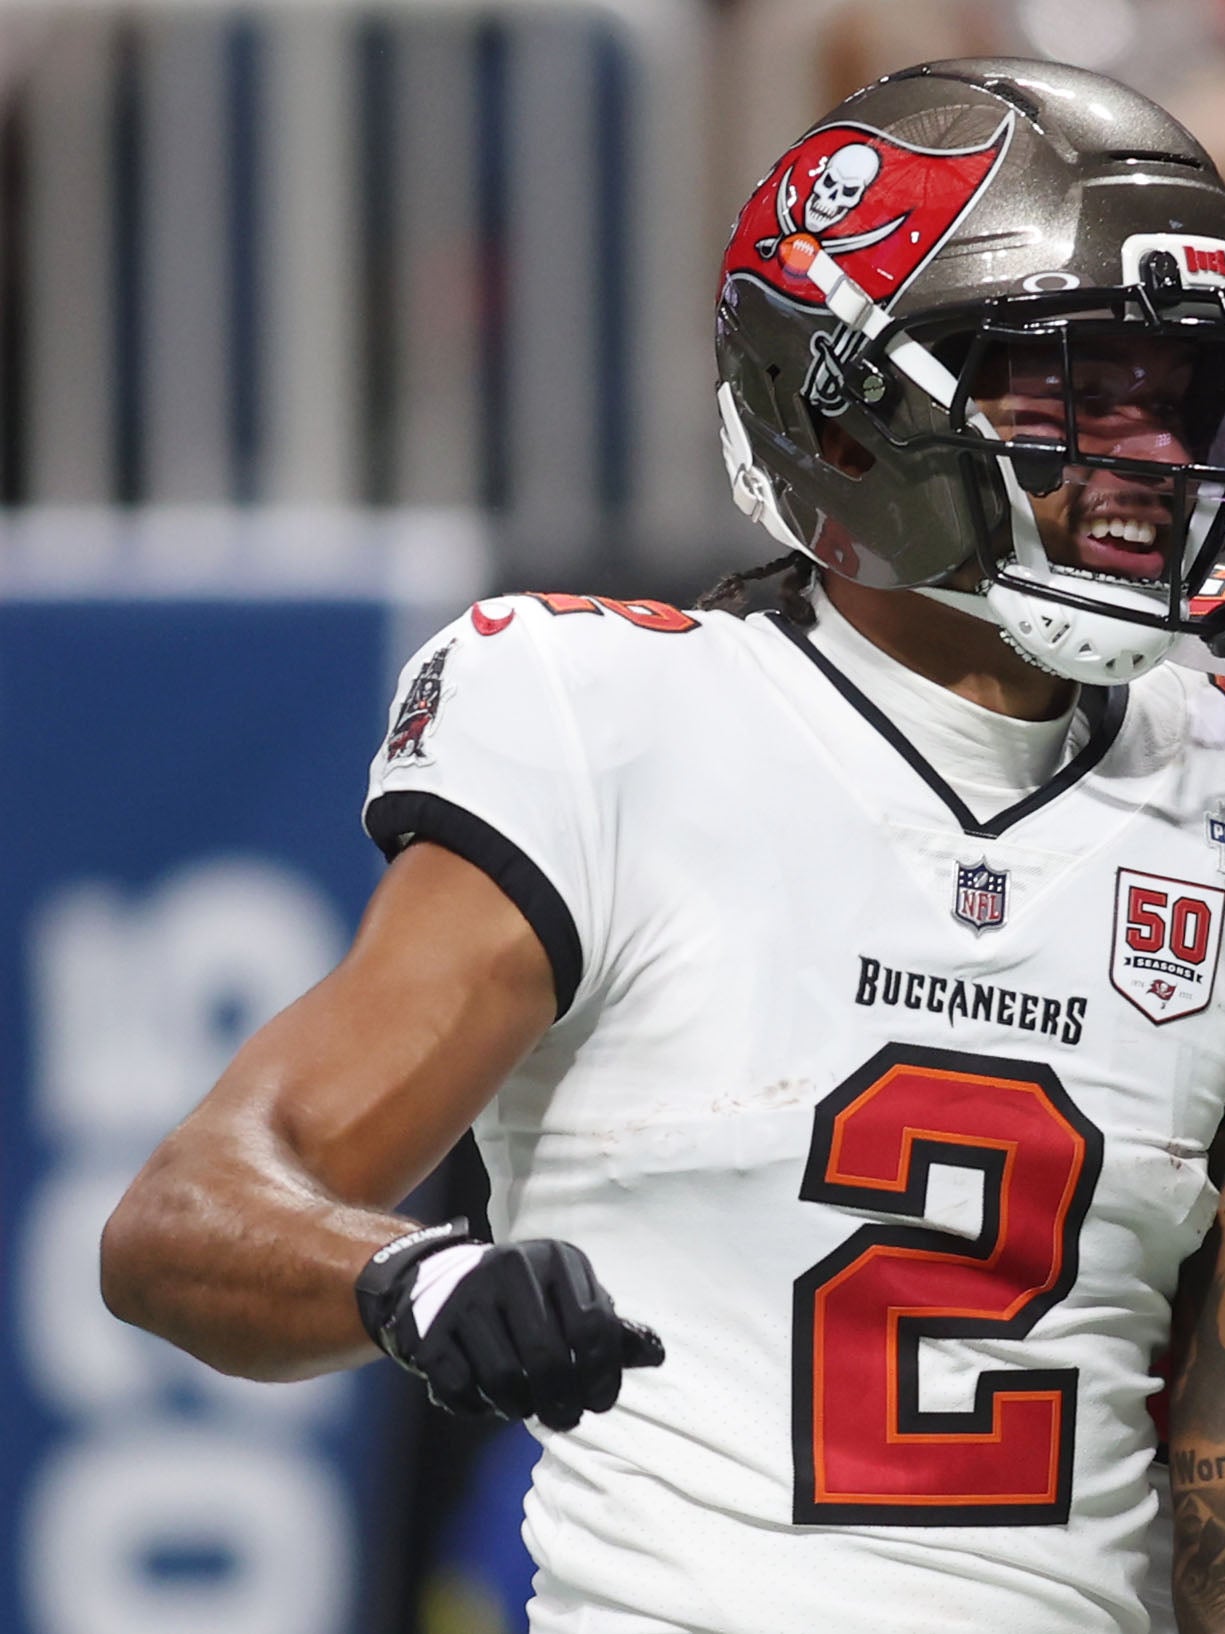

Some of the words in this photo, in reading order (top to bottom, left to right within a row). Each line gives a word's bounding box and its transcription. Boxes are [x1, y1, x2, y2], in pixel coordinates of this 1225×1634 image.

[961, 889, 1001, 921] NFL
[1125, 885, 1212, 965] 50
[855, 954, 1088, 1046] BUCCANEERS
[1136, 956, 1193, 979] SEASONS
[792, 1041, 1106, 1526] 2
